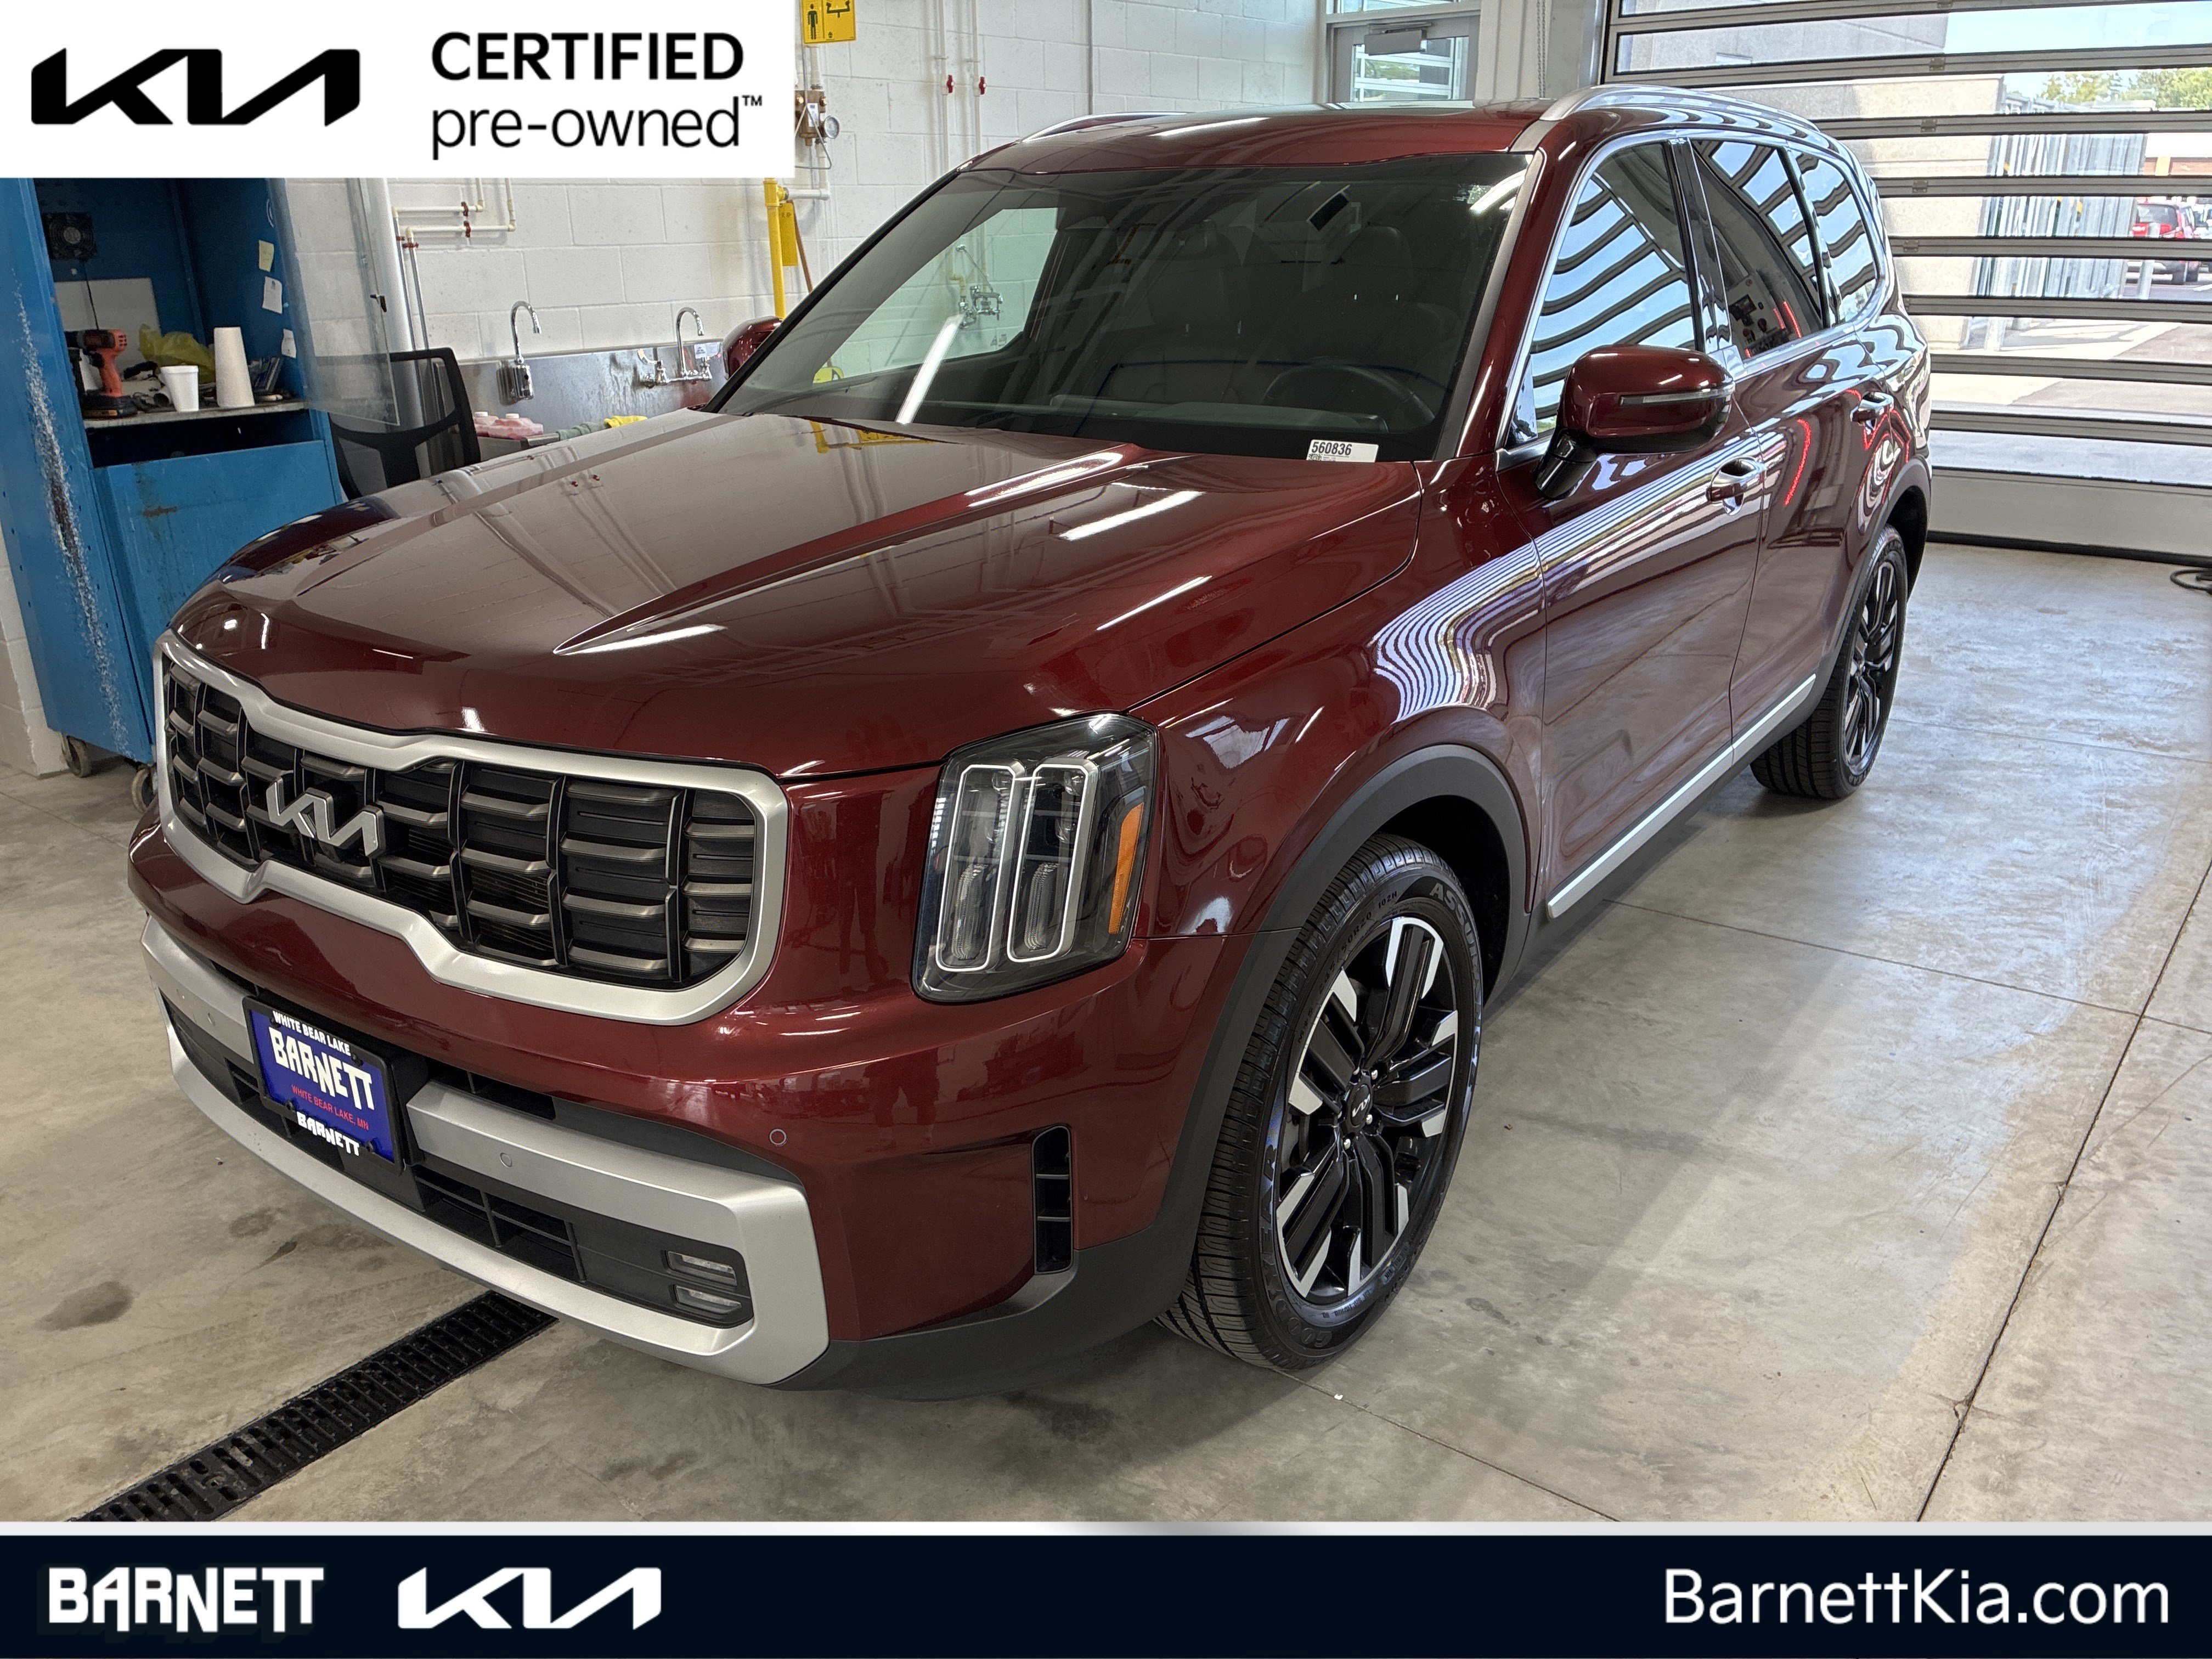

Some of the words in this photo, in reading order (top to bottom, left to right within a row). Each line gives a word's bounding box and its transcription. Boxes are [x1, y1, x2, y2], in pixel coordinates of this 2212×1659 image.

[1311, 441, 1352, 455] 560836
[266, 777, 385, 857] KIA
[1378, 890, 1397, 909] 102H
[273, 1011, 301, 1032] WHITE
[302, 1024, 325, 1045] BEAR
[326, 1035, 351, 1056] LAKE
[269, 1026, 375, 1110] BARNETT
[291, 1084, 313, 1103] WHITE
[313, 1096, 333, 1113] BEAR
[334, 1106, 356, 1125] LAKE,
[357, 1118, 369, 1131] MN
[296, 1111, 360, 1156] BARNETT
